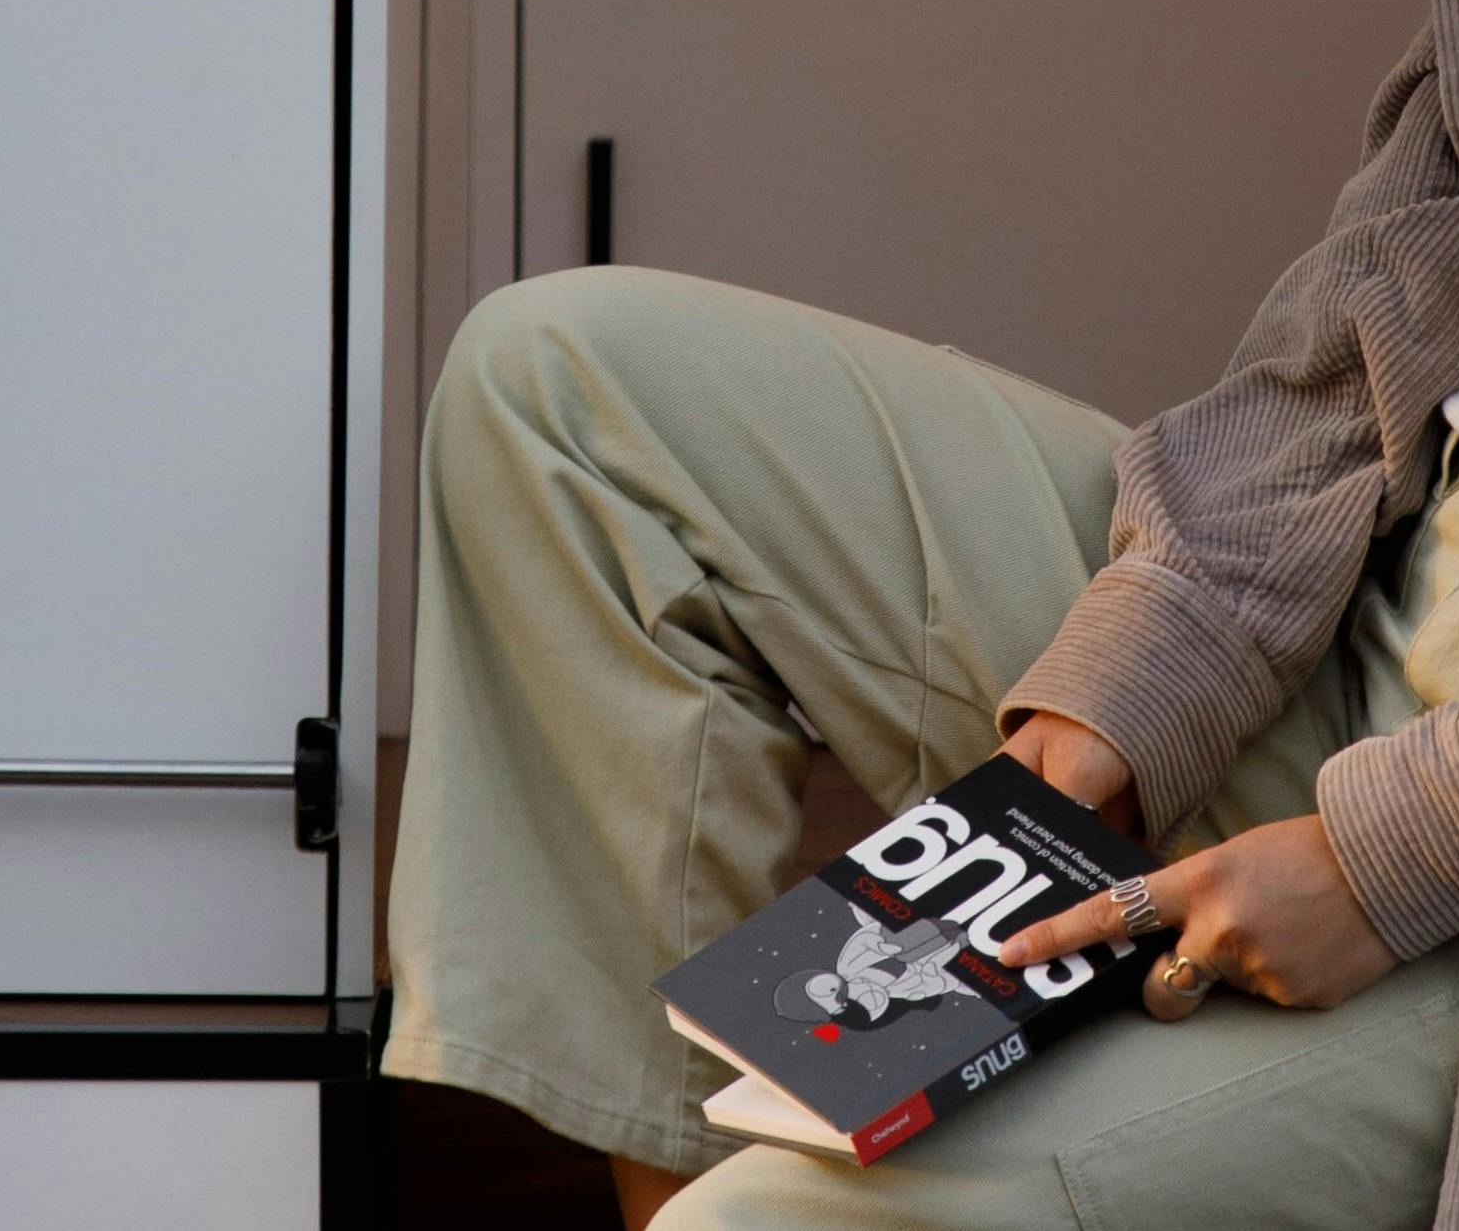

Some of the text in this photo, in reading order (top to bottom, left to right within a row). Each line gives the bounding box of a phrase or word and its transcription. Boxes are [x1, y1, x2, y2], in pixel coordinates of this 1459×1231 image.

[1006, 807, 1035, 830] friend
[1010, 827, 1041, 850] comics
[1032, 825, 1055, 843] best
[1036, 848, 1050, 858] of
[1052, 838, 1076, 859] your
[1049, 856, 1089, 885] collection
[1072, 852, 1101, 875] dating
[853, 876, 1017, 996] CATANA COMICS
[961, 1033, 1026, 1091] snug
